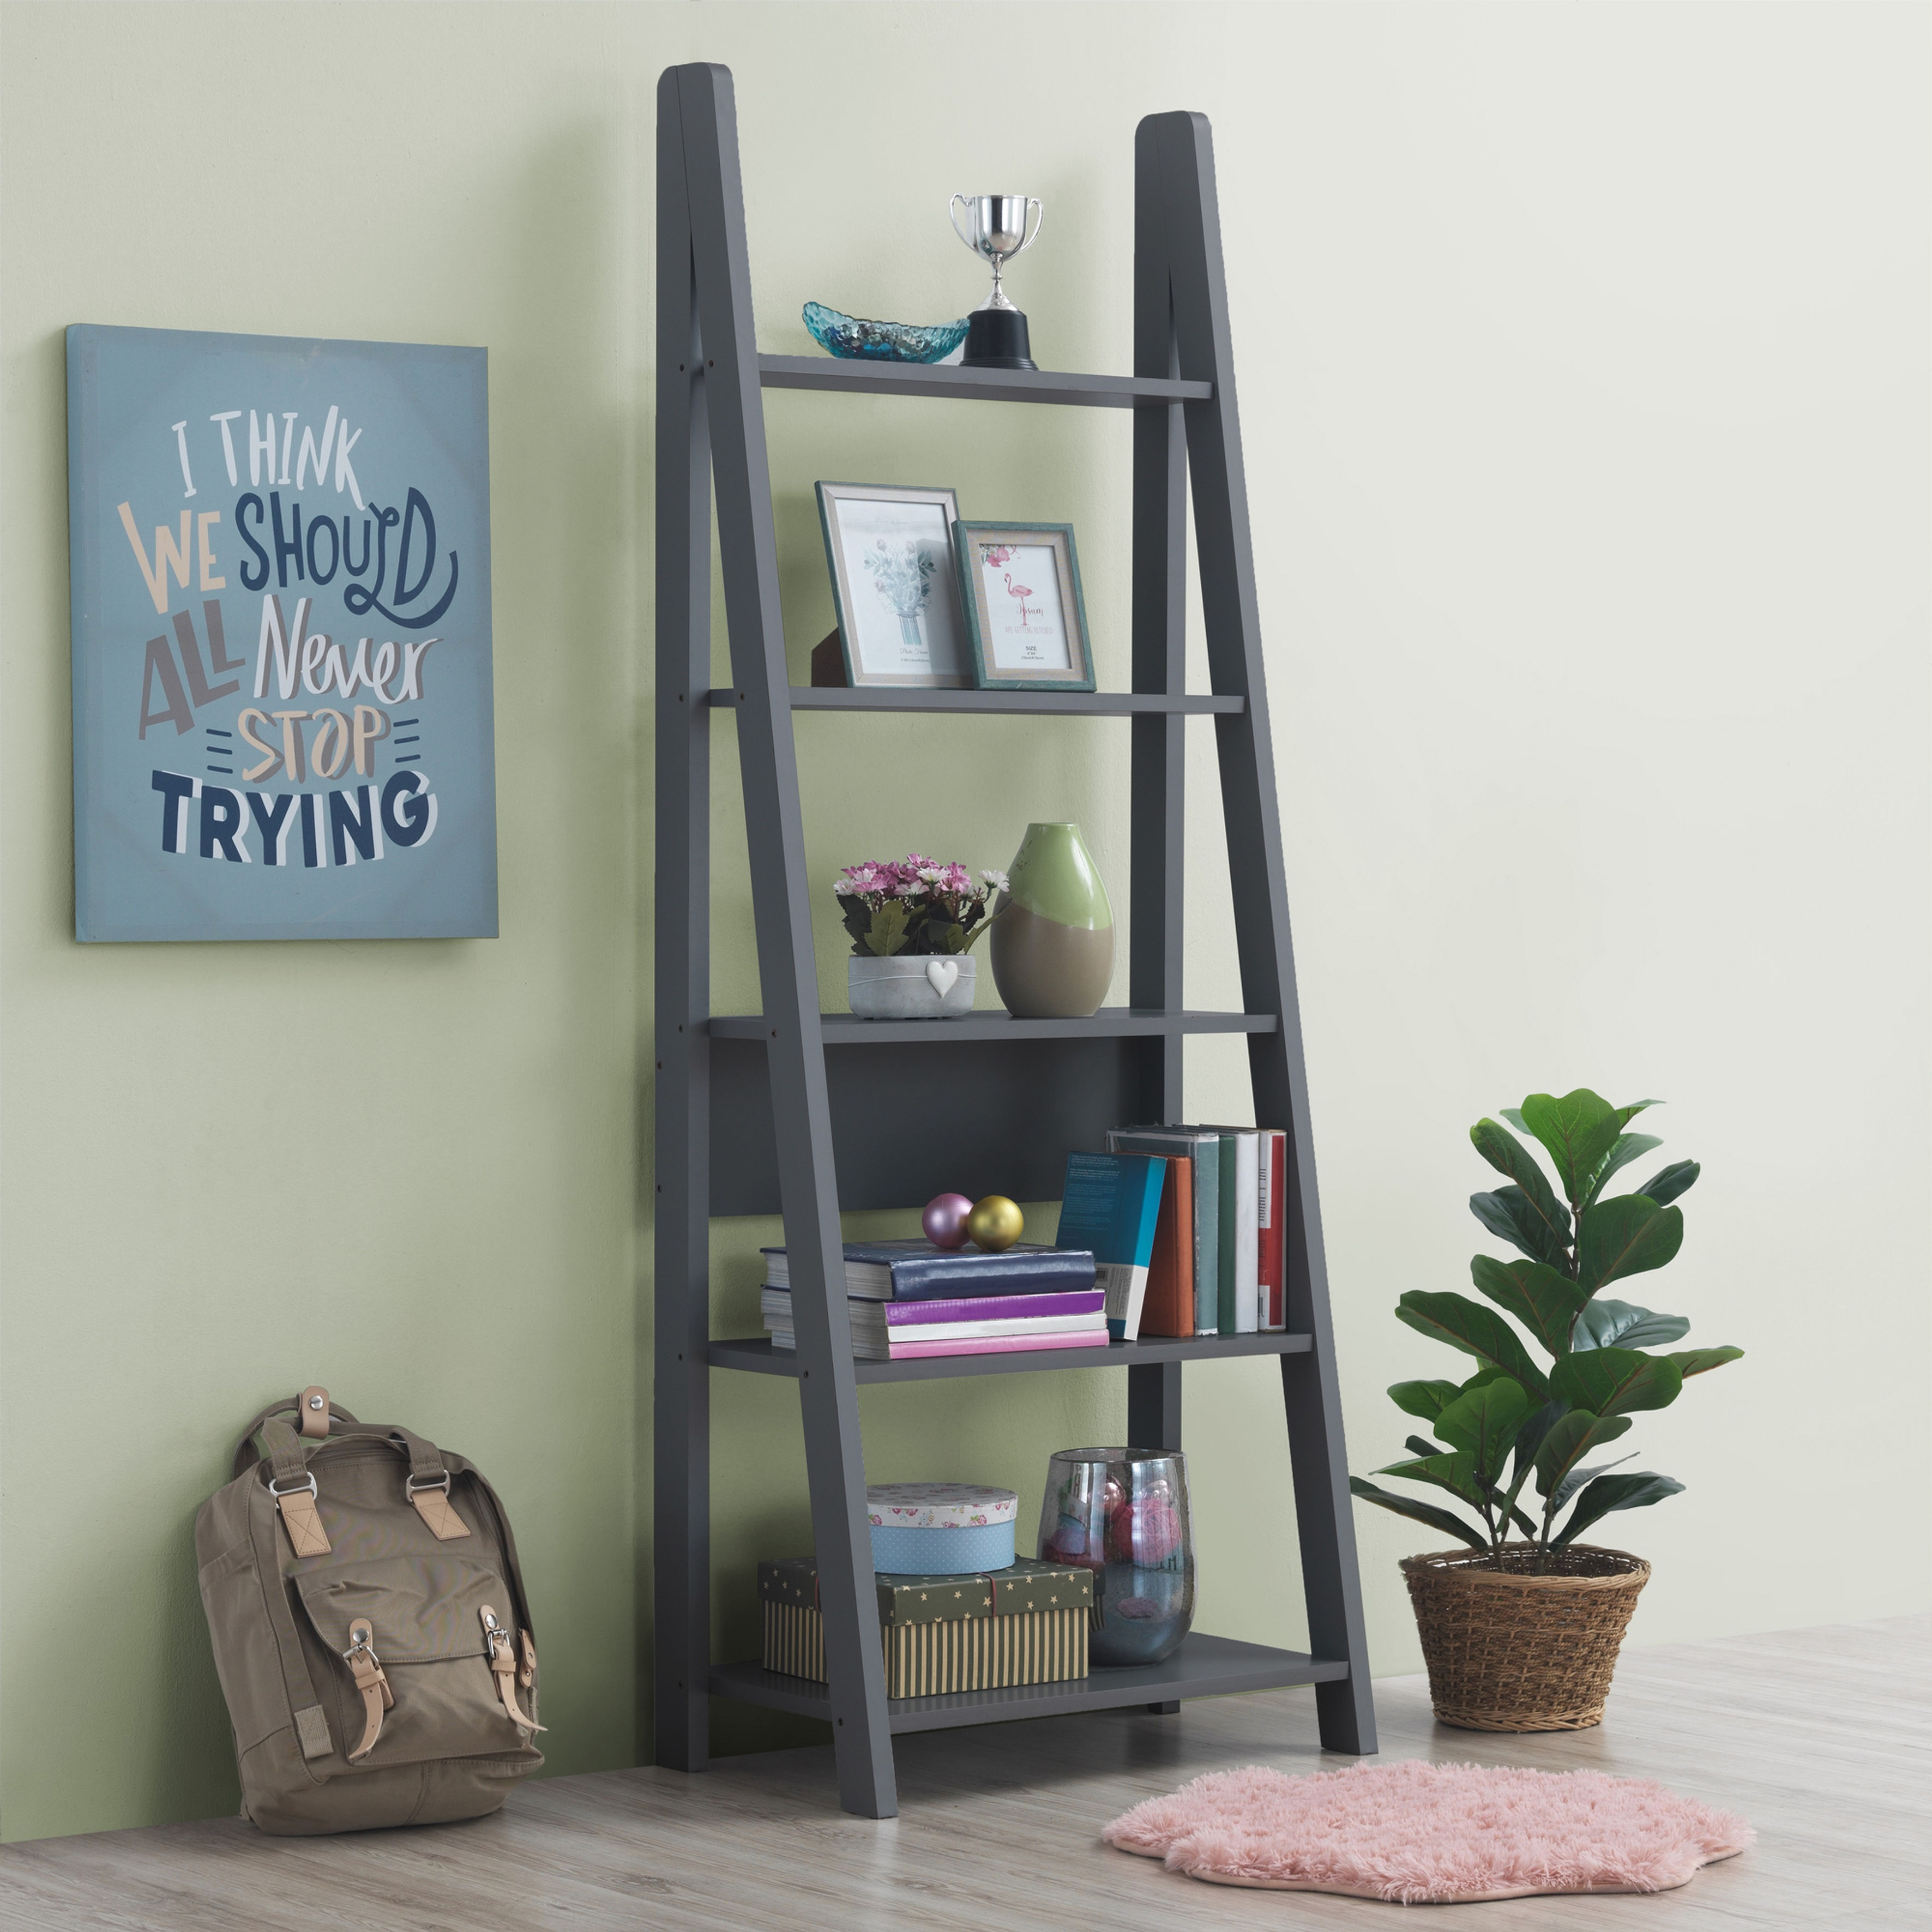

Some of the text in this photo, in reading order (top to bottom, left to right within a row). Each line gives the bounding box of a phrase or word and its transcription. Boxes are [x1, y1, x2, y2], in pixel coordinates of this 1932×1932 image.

[171, 405, 365, 510] I THINK
[117, 487, 458, 629] WE SHOULD
[139, 594, 443, 740] ALL Never
[238, 705, 392, 784] STOP
[152, 770, 437, 868] TRYING
